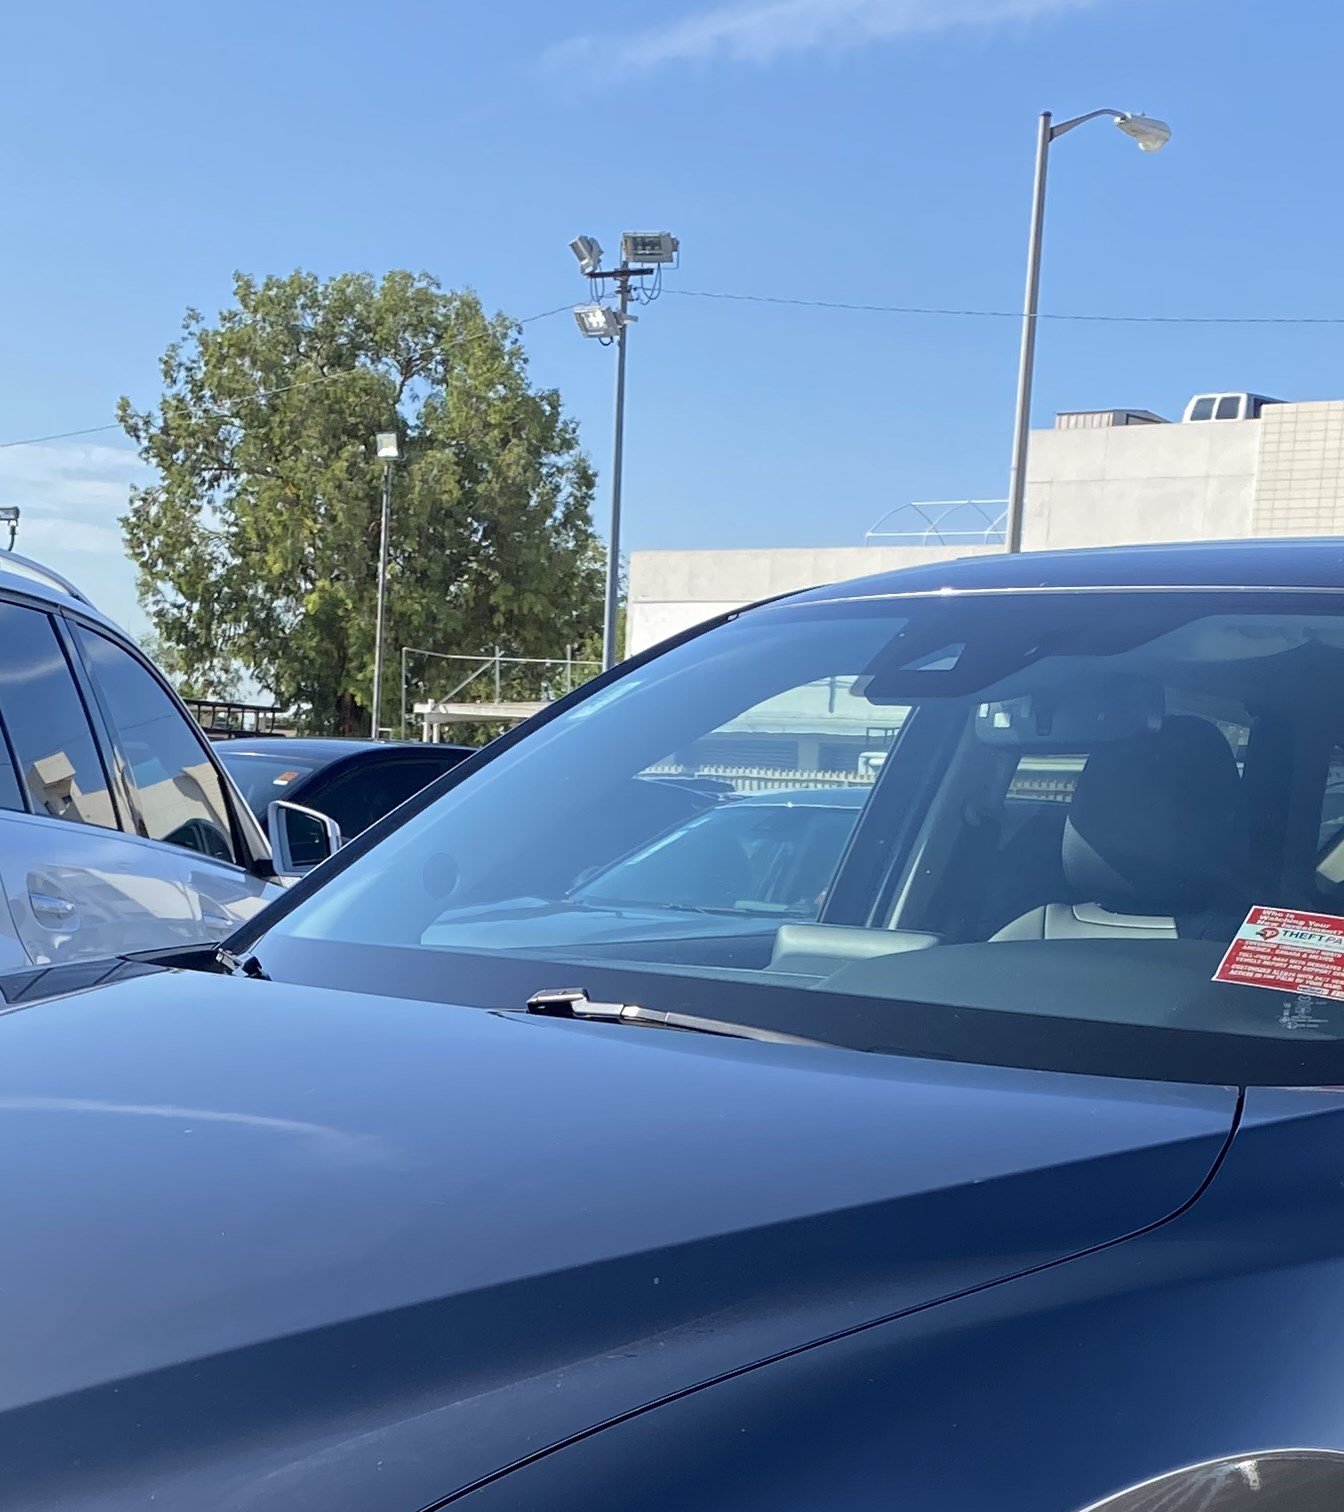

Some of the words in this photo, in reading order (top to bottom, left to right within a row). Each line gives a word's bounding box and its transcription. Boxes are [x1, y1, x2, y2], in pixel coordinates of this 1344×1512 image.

[1259, 915, 1306, 926] Watching
[1308, 920, 1332, 929] Your
[1281, 922, 1344, 935] Investment?
